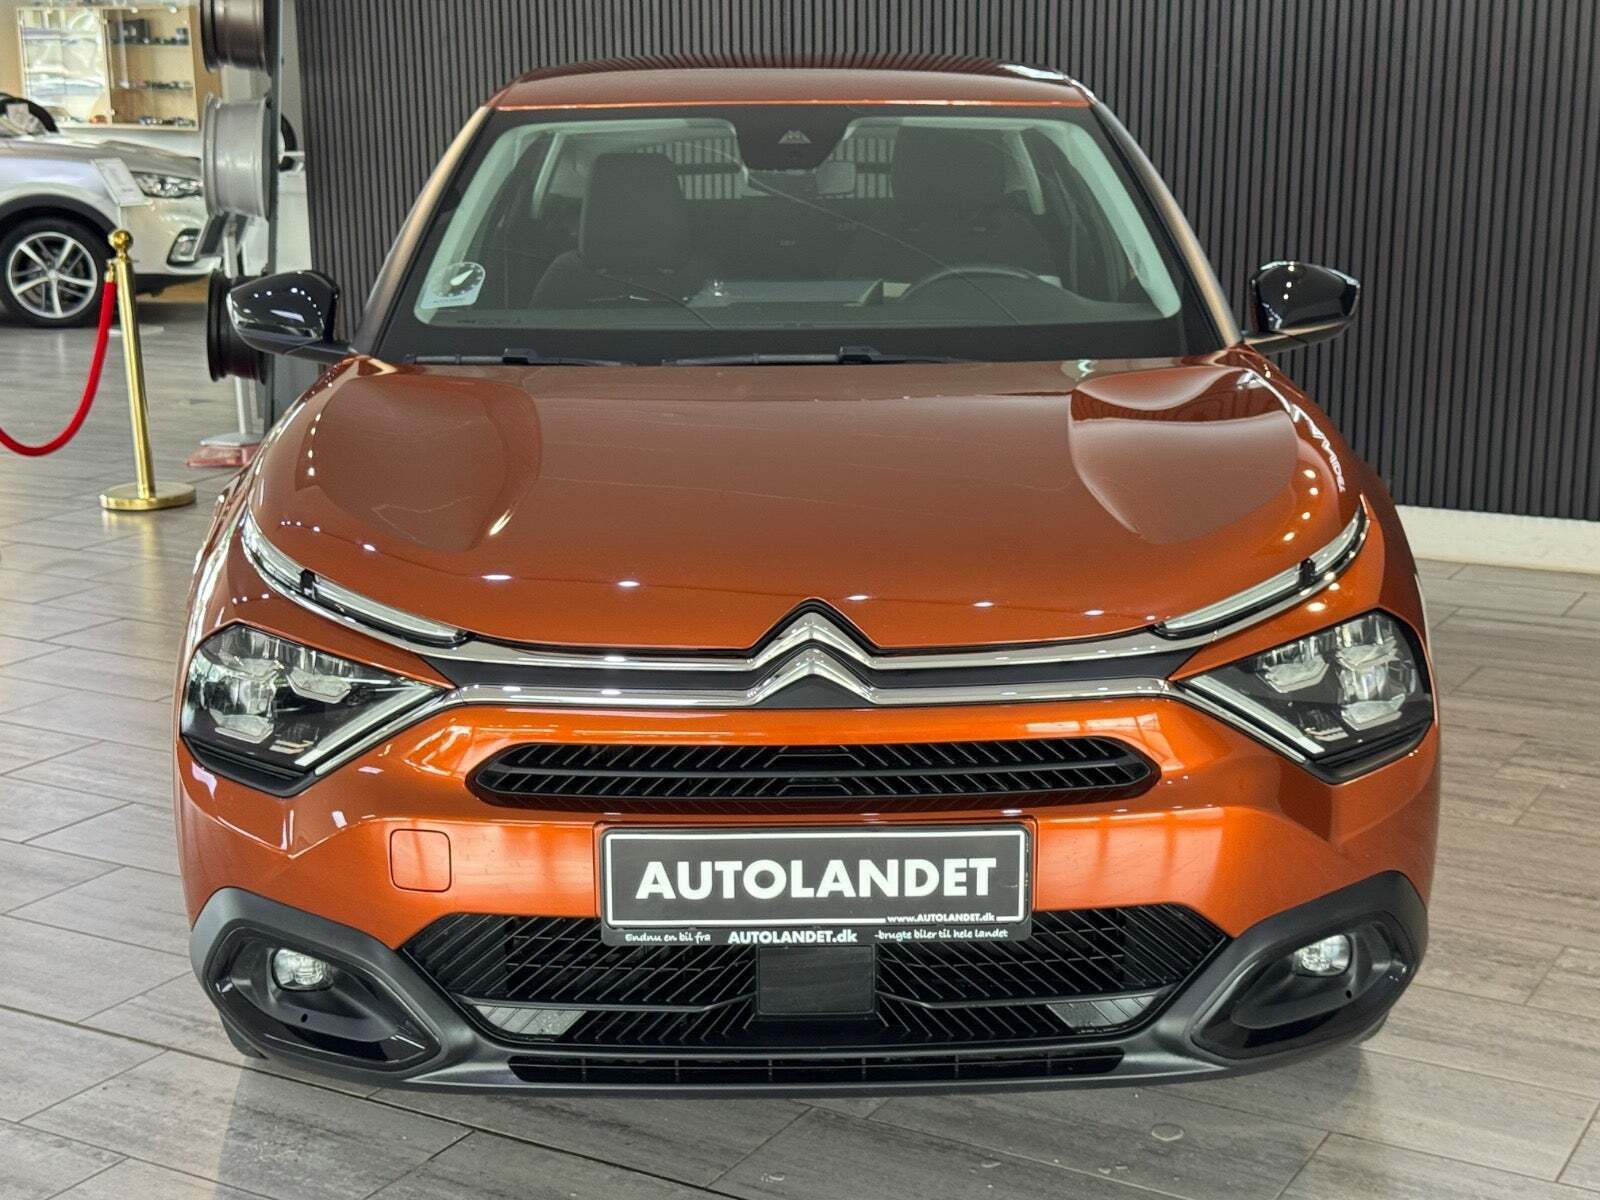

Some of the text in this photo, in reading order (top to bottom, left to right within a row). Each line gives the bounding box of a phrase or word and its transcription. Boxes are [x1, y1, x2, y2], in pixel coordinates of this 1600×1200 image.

[635, 857, 997, 900] AUTOLANDET
[886, 912, 996, 923] www.AUTOLANDET.dk
[624, 928, 1009, 945] Endnu en bil fra AUTOLANDET.dk -brugte biler til hele landet
